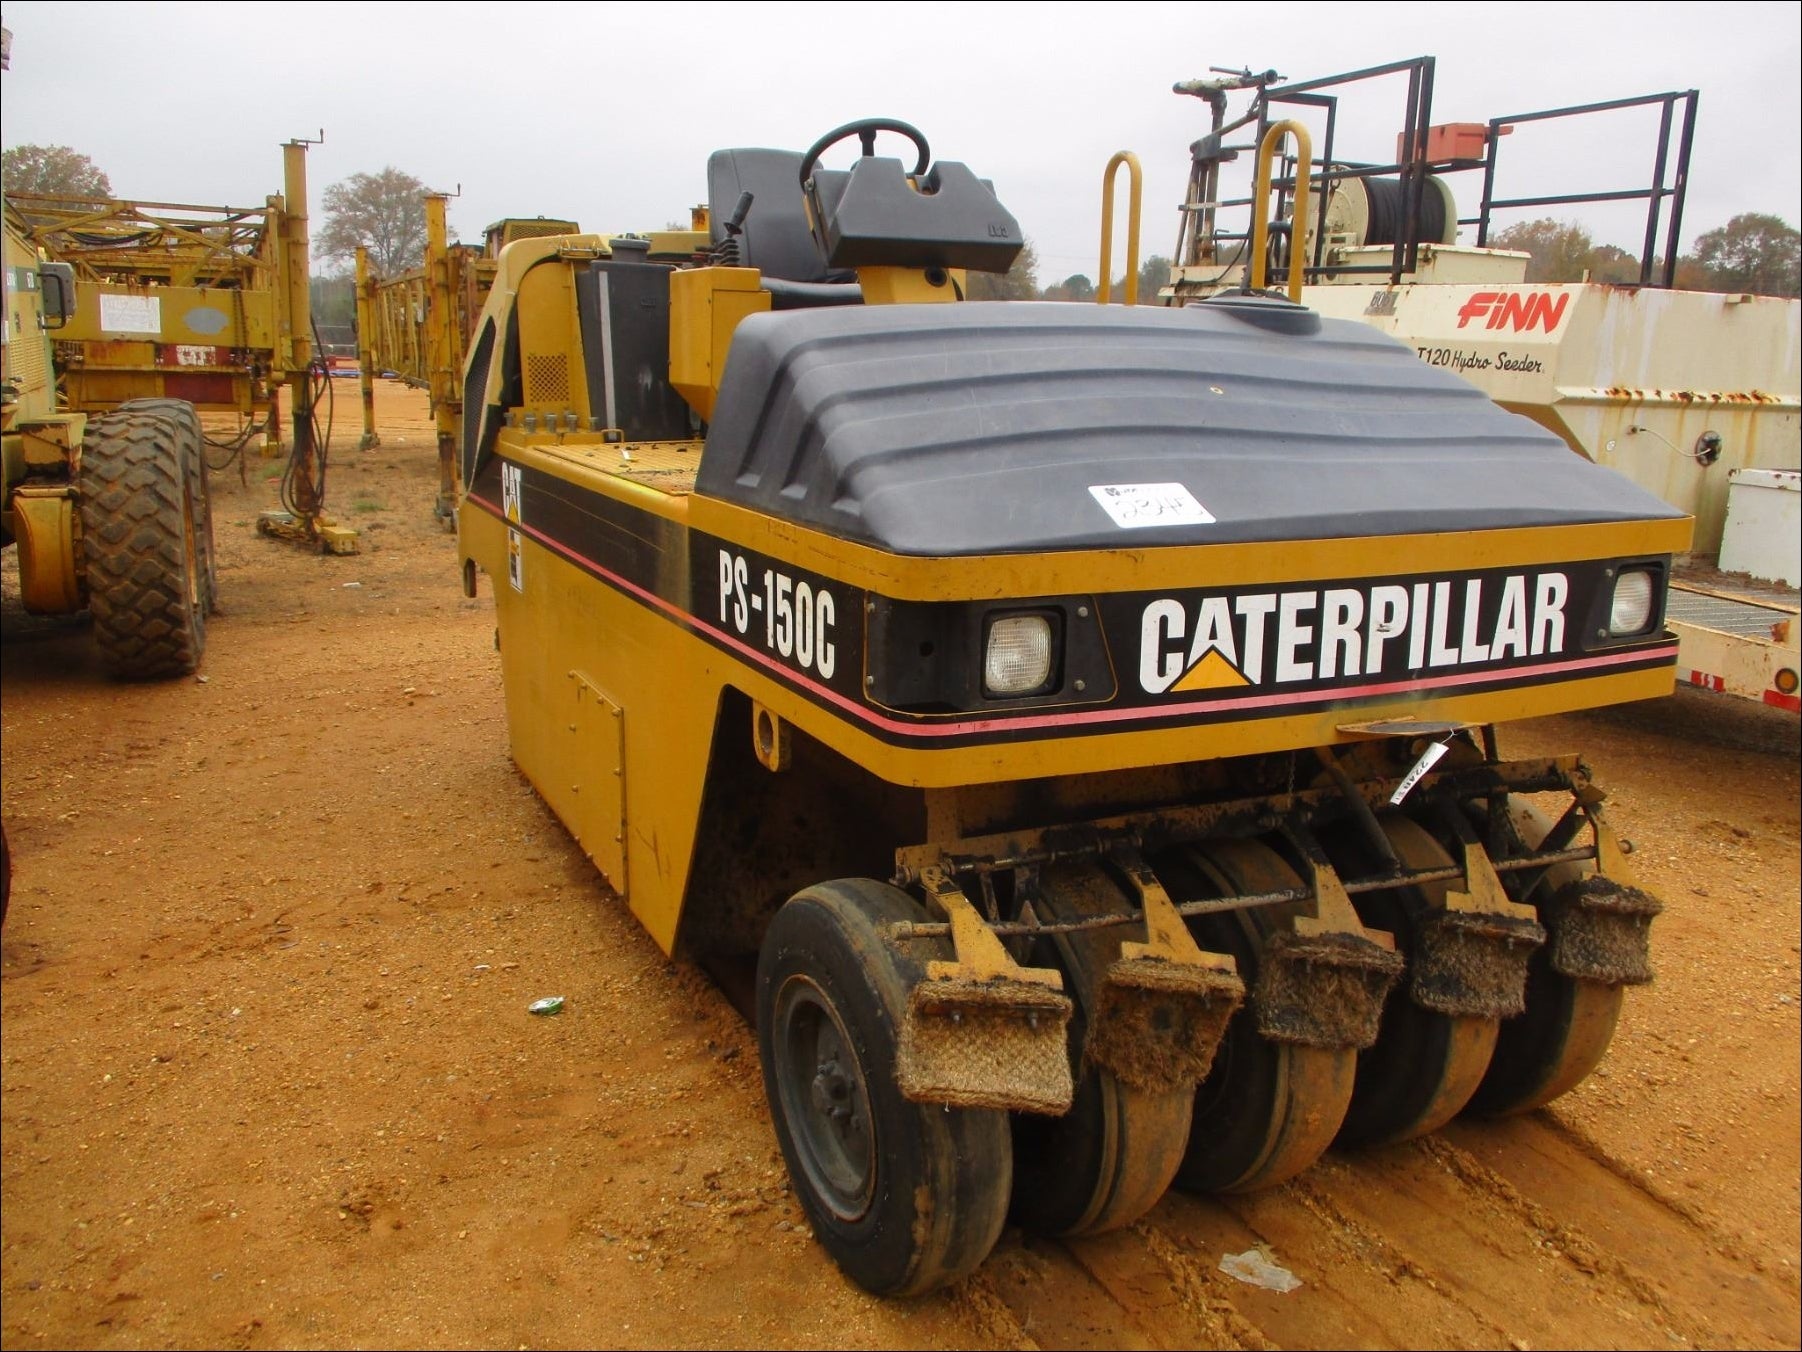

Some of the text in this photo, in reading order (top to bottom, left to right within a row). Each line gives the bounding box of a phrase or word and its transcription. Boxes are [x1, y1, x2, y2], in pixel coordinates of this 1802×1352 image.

[1451, 350, 1492, 373] Hydro
[501, 461, 522, 526] CAT
[719, 549, 835, 680] PS-150C
[1139, 572, 1568, 694] CATERPILLAR
